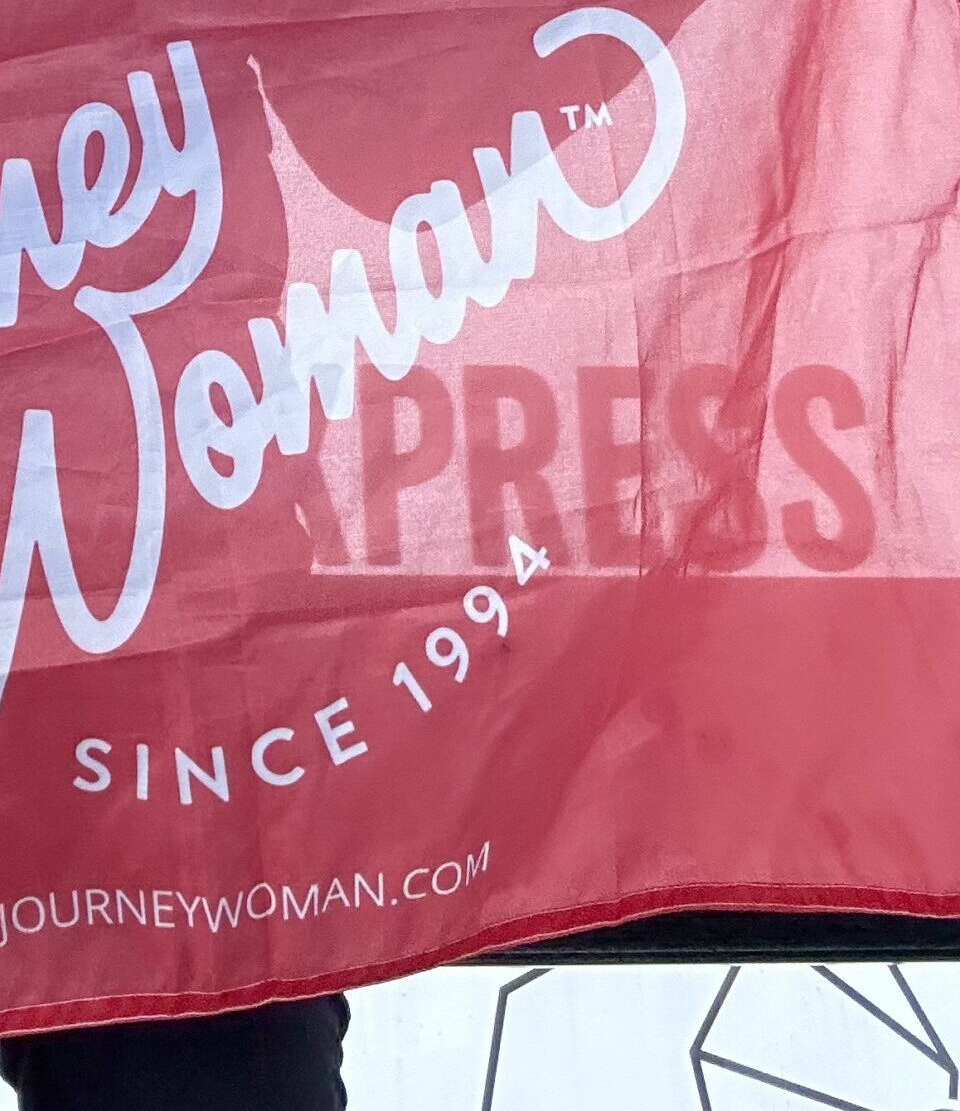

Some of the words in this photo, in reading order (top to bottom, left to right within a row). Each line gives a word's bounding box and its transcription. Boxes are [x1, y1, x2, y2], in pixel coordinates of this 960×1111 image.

[559, 101, 613, 131] TM
[73, 697, 368, 805] SINCE
[392, 534, 551, 713] 1994
